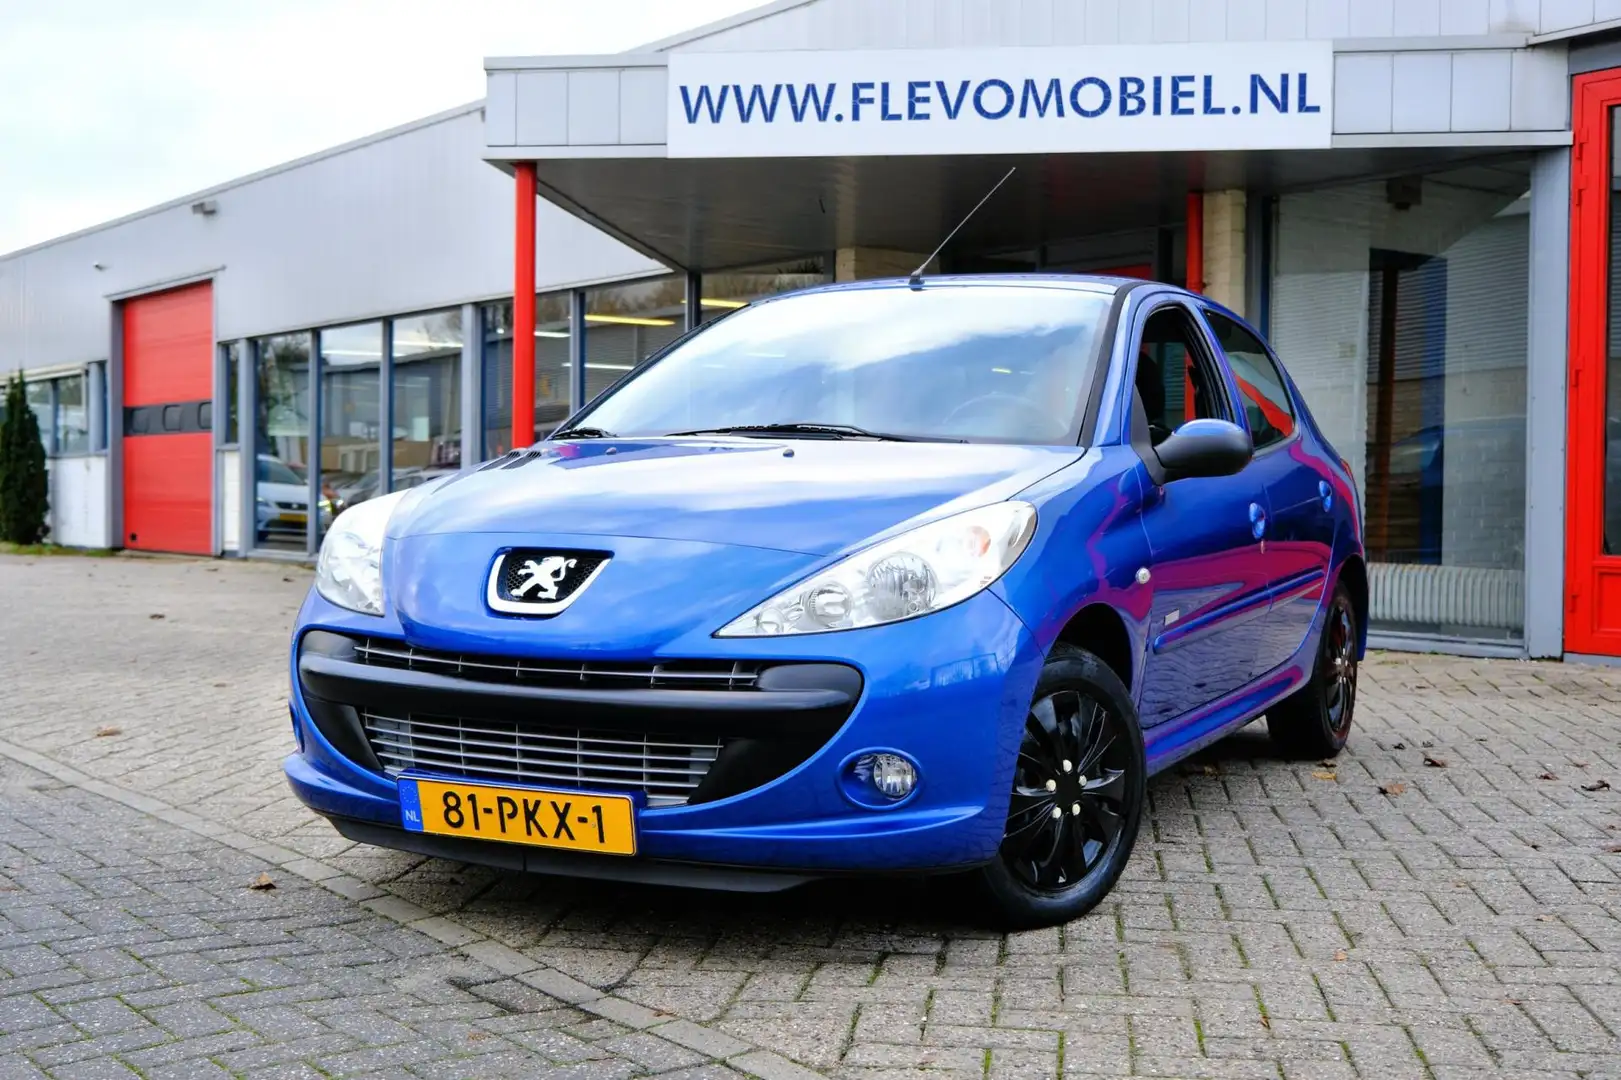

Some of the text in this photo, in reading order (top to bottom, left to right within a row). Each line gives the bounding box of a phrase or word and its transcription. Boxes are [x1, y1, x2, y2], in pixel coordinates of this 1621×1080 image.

[679, 72, 1321, 124] WWW.FLEVOMOBIEL.NL
[405, 810, 420, 823] NL
[442, 790, 605, 844] 81-PKX-1
